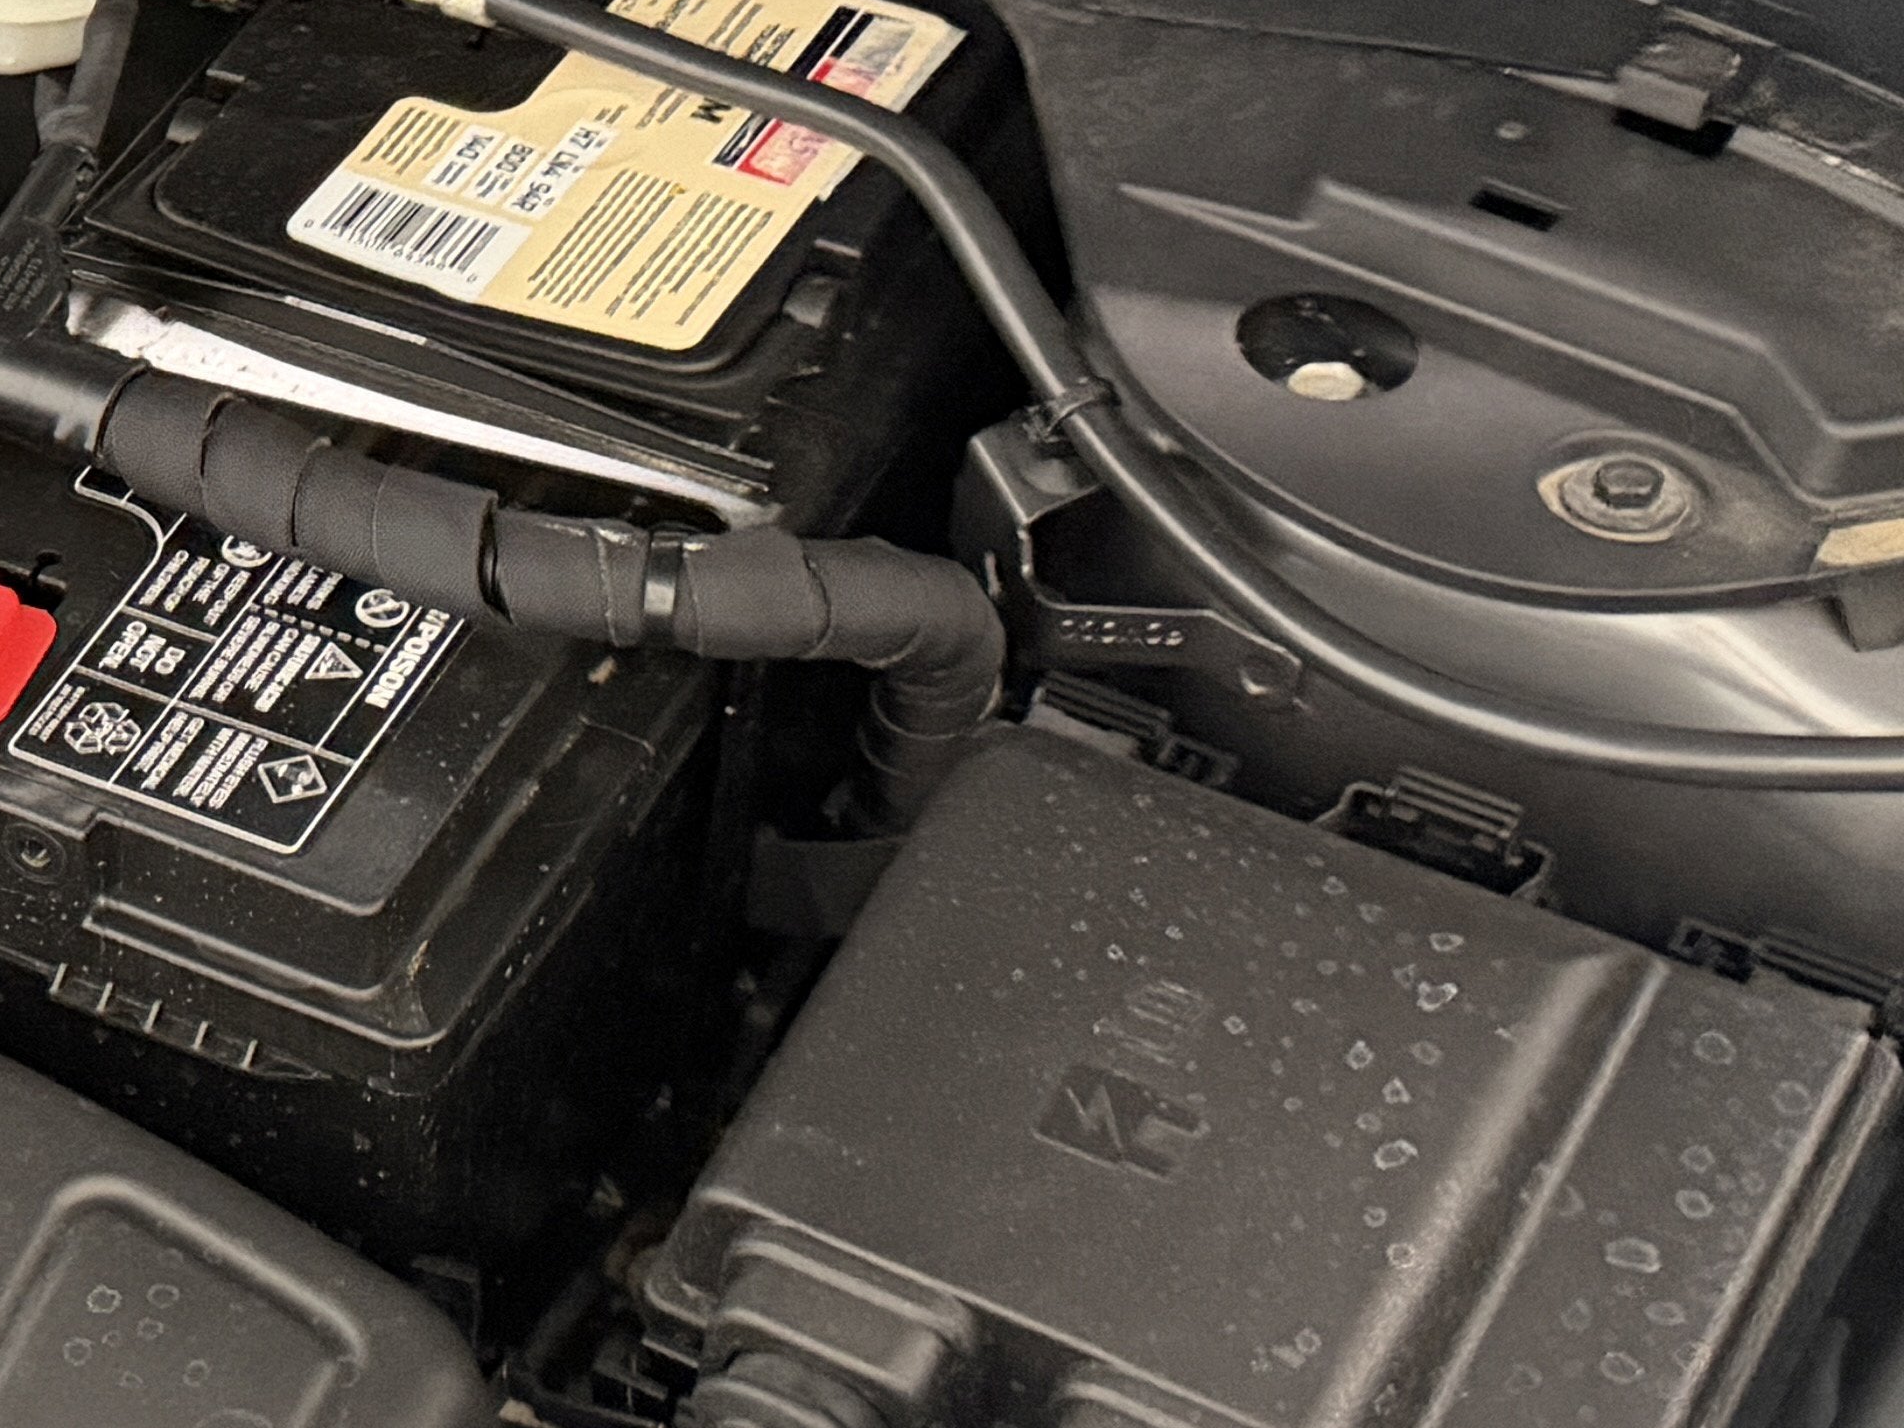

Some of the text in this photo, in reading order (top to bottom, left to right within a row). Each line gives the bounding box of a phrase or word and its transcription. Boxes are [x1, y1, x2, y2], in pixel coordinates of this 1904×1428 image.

[495, 144, 535, 173] 800
[192, 563, 231, 604] OF THE
[203, 599, 228, 627] OUT
[98, 620, 147, 669] OPEN.
[129, 633, 167, 672] NOT
[154, 646, 186, 675] DO
[243, 628, 299, 693] CAN CAUSE
[204, 727, 235, 757] WITH
